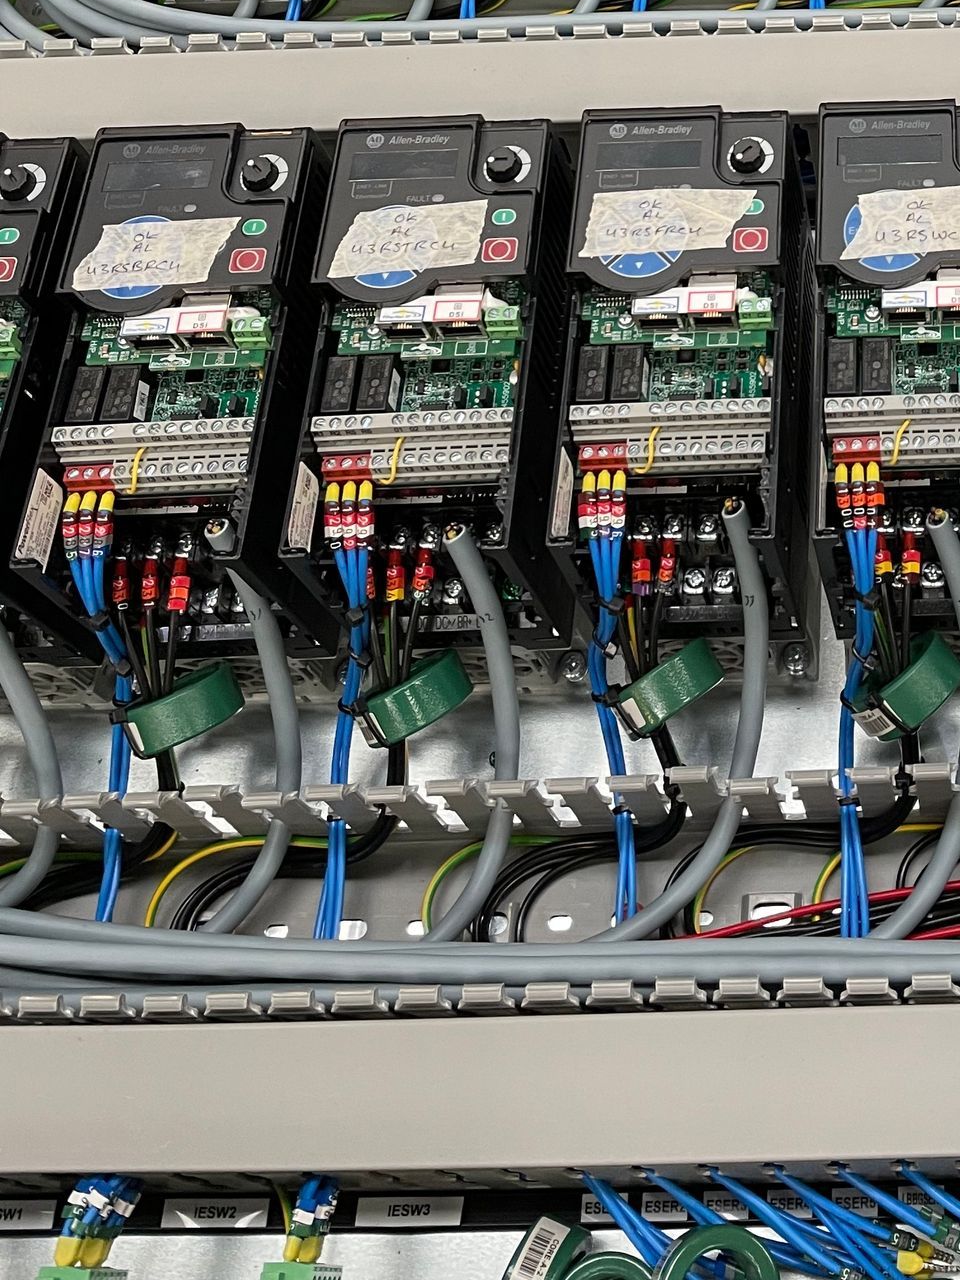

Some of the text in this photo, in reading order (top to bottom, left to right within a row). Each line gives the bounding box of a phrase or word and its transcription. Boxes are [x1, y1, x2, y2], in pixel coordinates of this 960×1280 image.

[632, 125, 692, 135] Allen-Bradley
[872, 120, 930, 130] Allen-Bradley
[389, 135, 450, 145] Allen-Bradley
[145, 144, 206, 154] Allen-Bradley
[406, 195, 430, 203] FAULT
[639, 200, 662, 210] OK
[907, 200, 933, 210] OK
[394, 214, 417, 223] OK
[643, 211, 664, 219] AL
[905, 213, 930, 224] AL
[134, 232, 160, 241] OK
[132, 243, 152, 252] AL
[835, 1195, 876, 1209] ESER5
[194, 1205, 236, 1219] IESW2
[387, 1204, 430, 1217] IESW3
[534, 1239, 560, 1277] CORE-A-2
